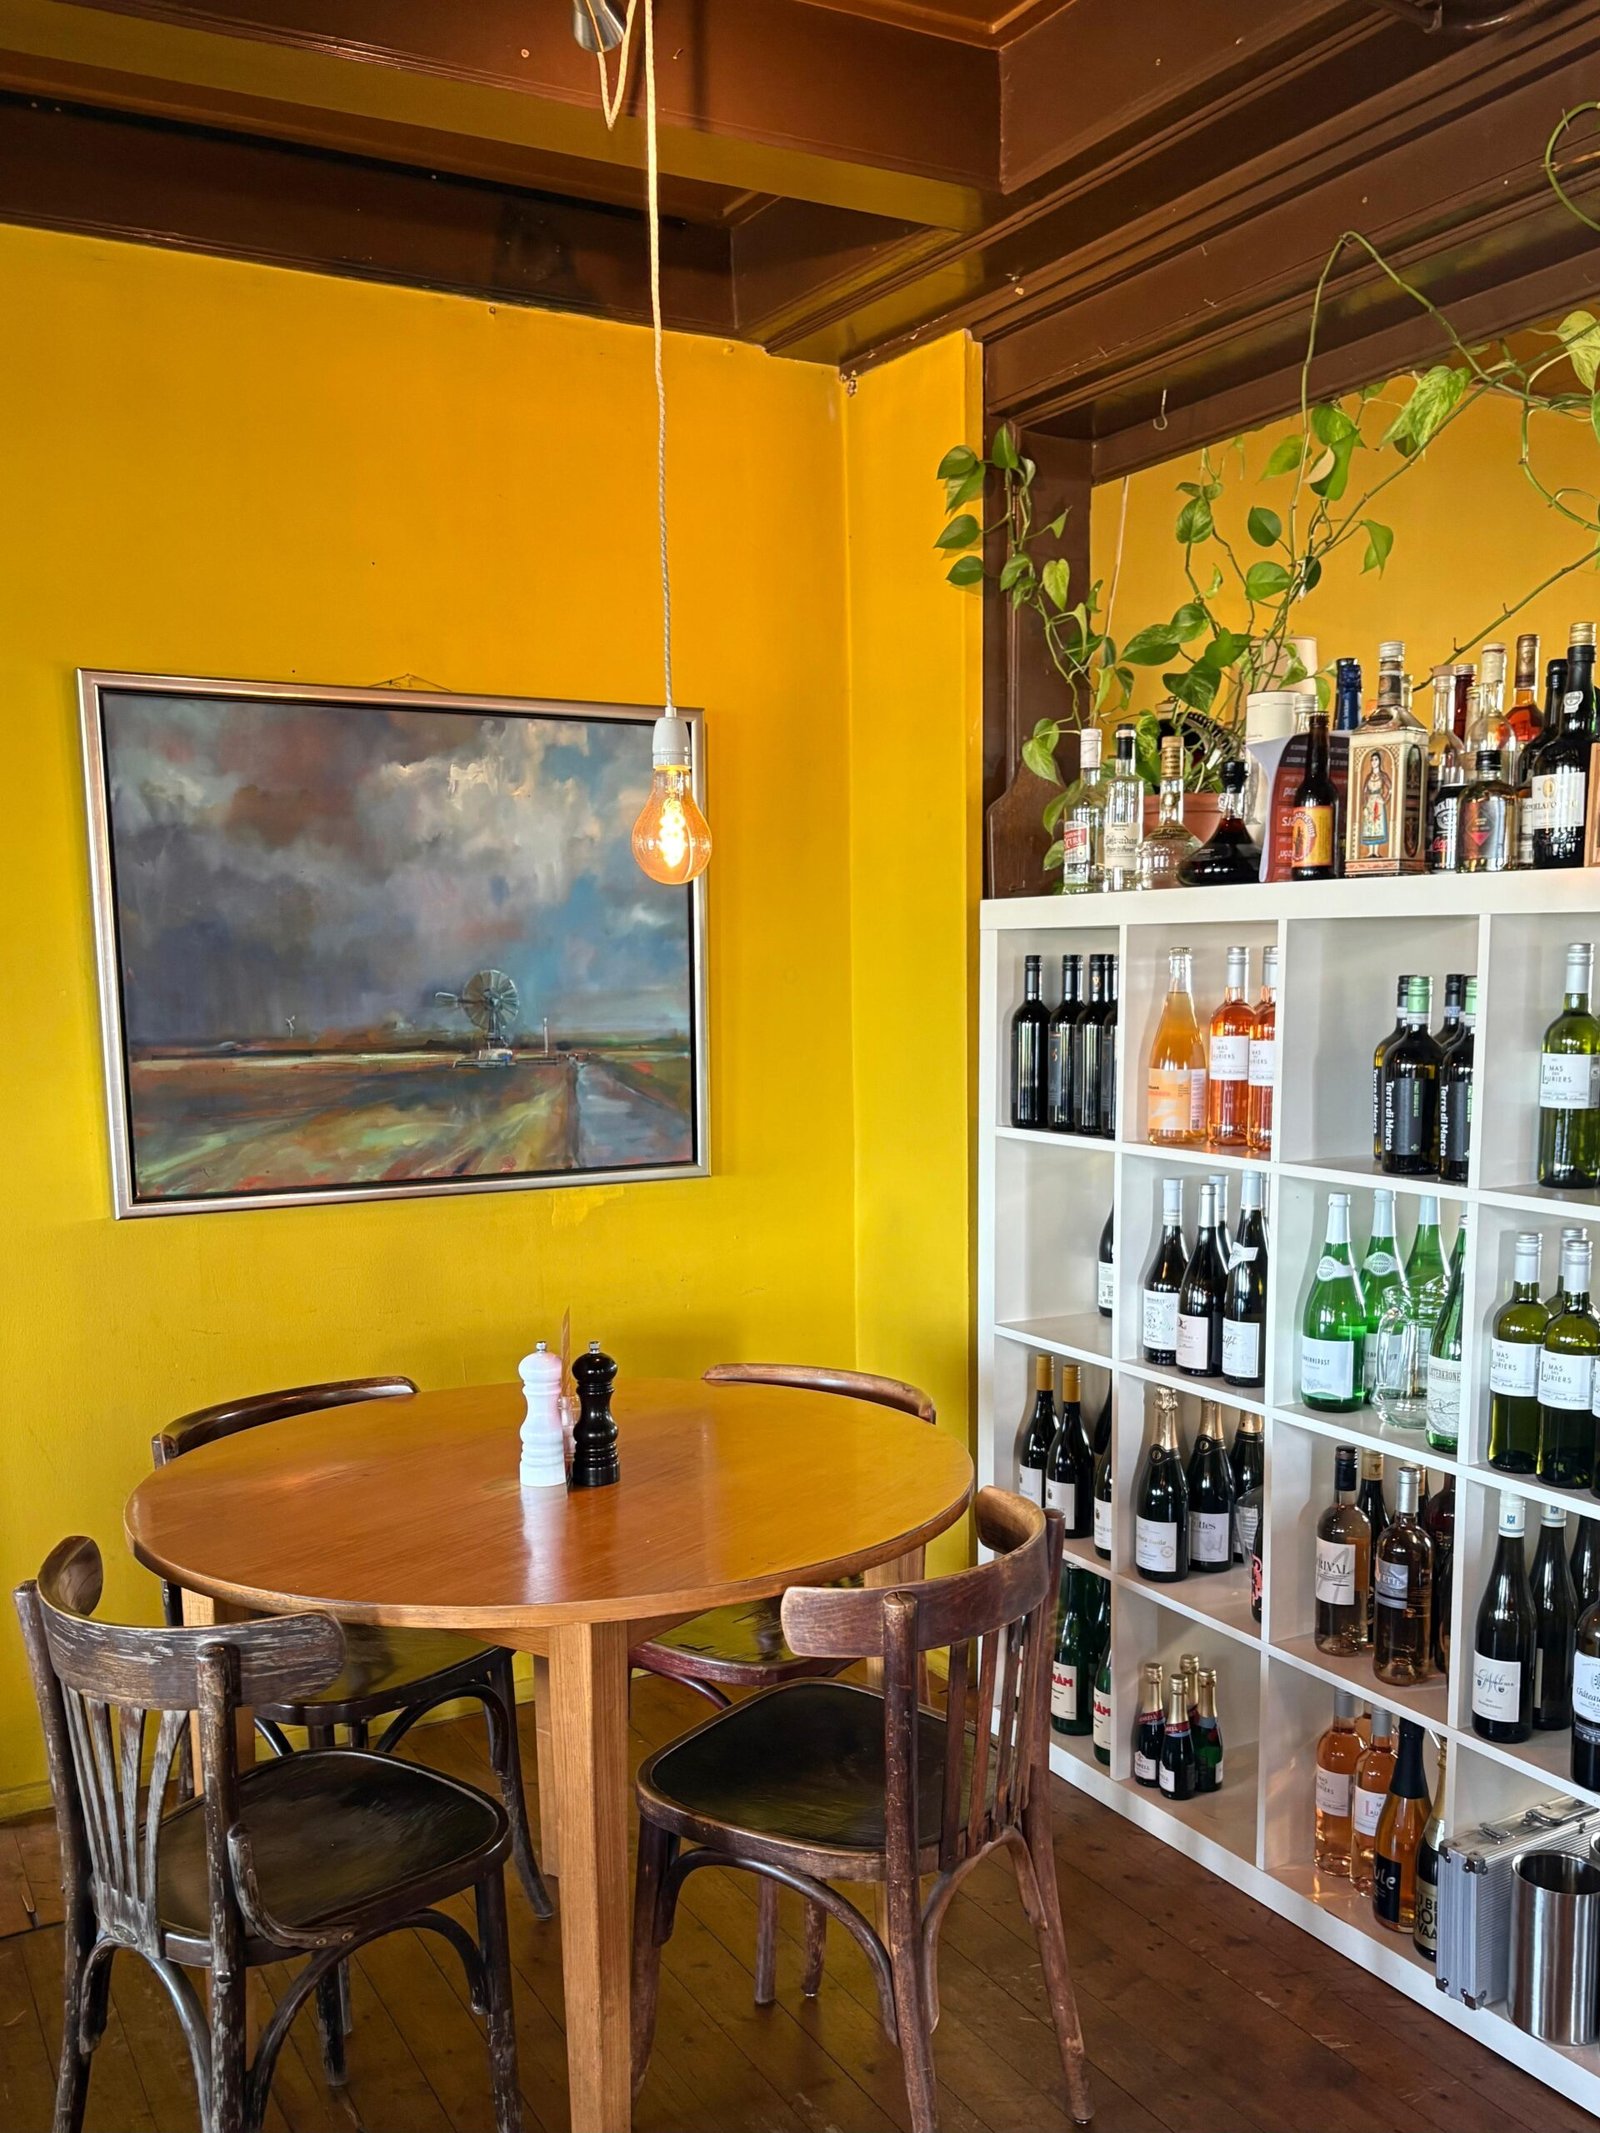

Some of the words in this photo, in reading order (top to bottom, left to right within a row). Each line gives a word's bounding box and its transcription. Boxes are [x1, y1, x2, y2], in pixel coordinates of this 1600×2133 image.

[1386, 1081, 1395, 1107] Terre
[1440, 1085, 1449, 1112] Terre
[1386, 1108, 1395, 1118] di
[1440, 1113, 1449, 1123] di
[1385, 1119, 1394, 1152] Marca
[1440, 1123, 1449, 1157] Marca
